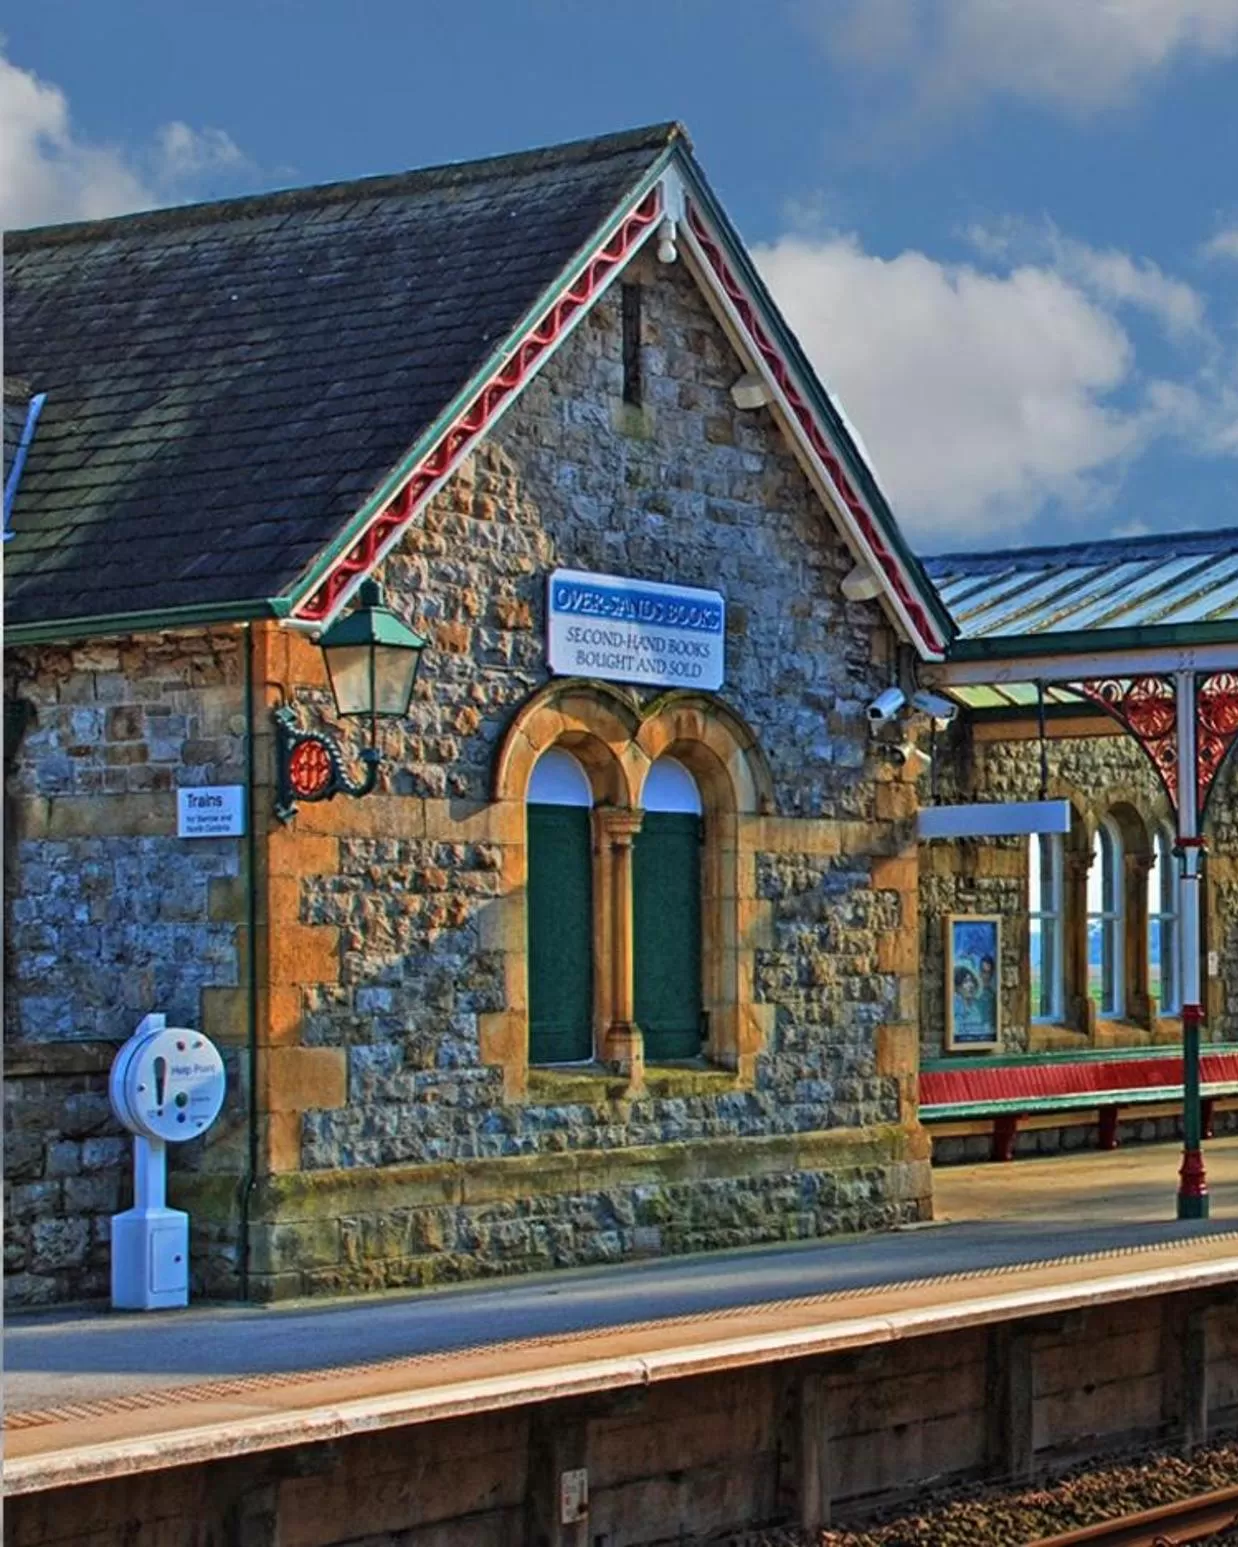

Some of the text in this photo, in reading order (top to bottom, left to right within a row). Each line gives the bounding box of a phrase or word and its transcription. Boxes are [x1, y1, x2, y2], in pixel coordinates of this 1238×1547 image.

[668, 603, 720, 630] BOOKS
[566, 626, 711, 658] SECOND-HAND BOOKS
[575, 650, 703, 678] BOUGHT AND SOLD
[187, 792, 223, 809] Trains
